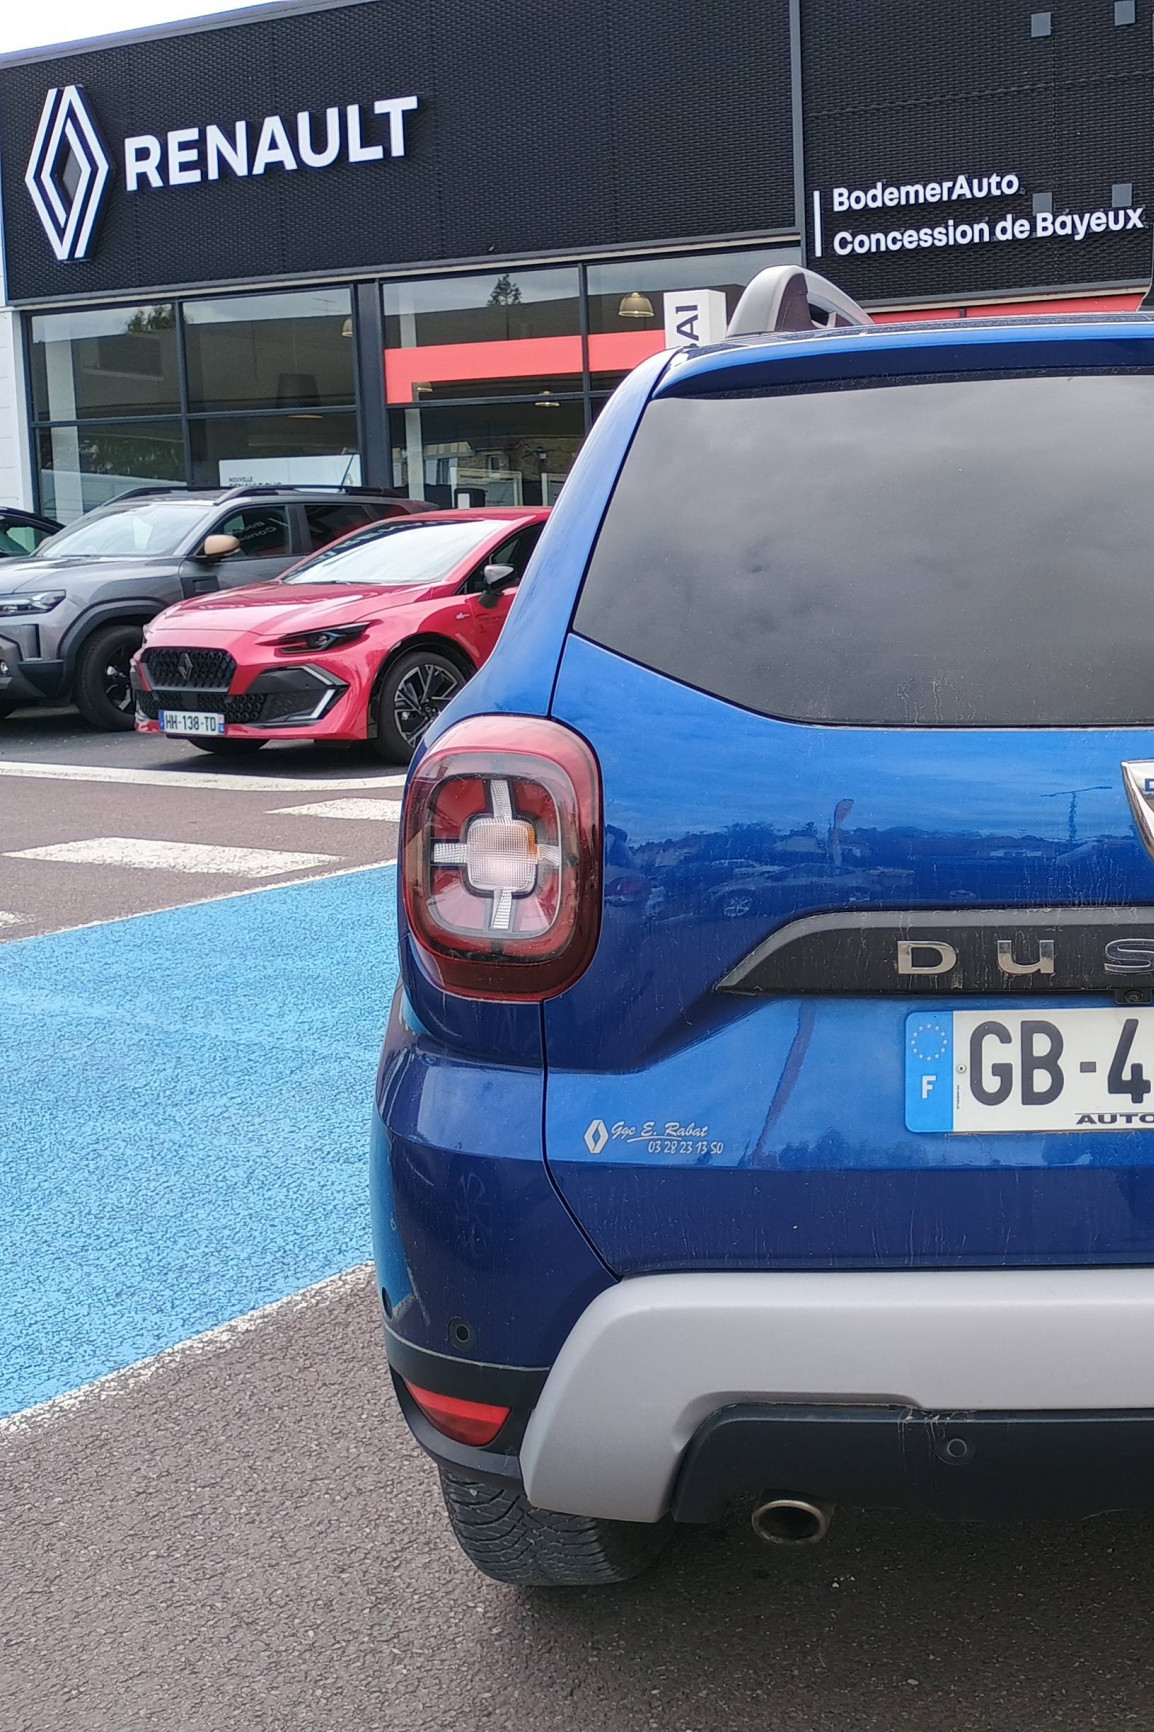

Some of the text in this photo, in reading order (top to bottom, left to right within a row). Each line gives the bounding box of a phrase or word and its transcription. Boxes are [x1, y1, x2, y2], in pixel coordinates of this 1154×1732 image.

[123, 95, 418, 192] RENAULT
[832, 172, 1020, 212] BodemerAuto
[832, 206, 1145, 256] Concession de Bayeux
[921, 1074, 937, 1099] F
[640, 1121, 657, 1137] E.
[664, 1121, 709, 1137] Rabat
[648, 1140, 661, 1153] 03
[664, 1141, 677, 1154] 28
[680, 1141, 693, 1154] 23
[696, 1141, 707, 1154] 13
